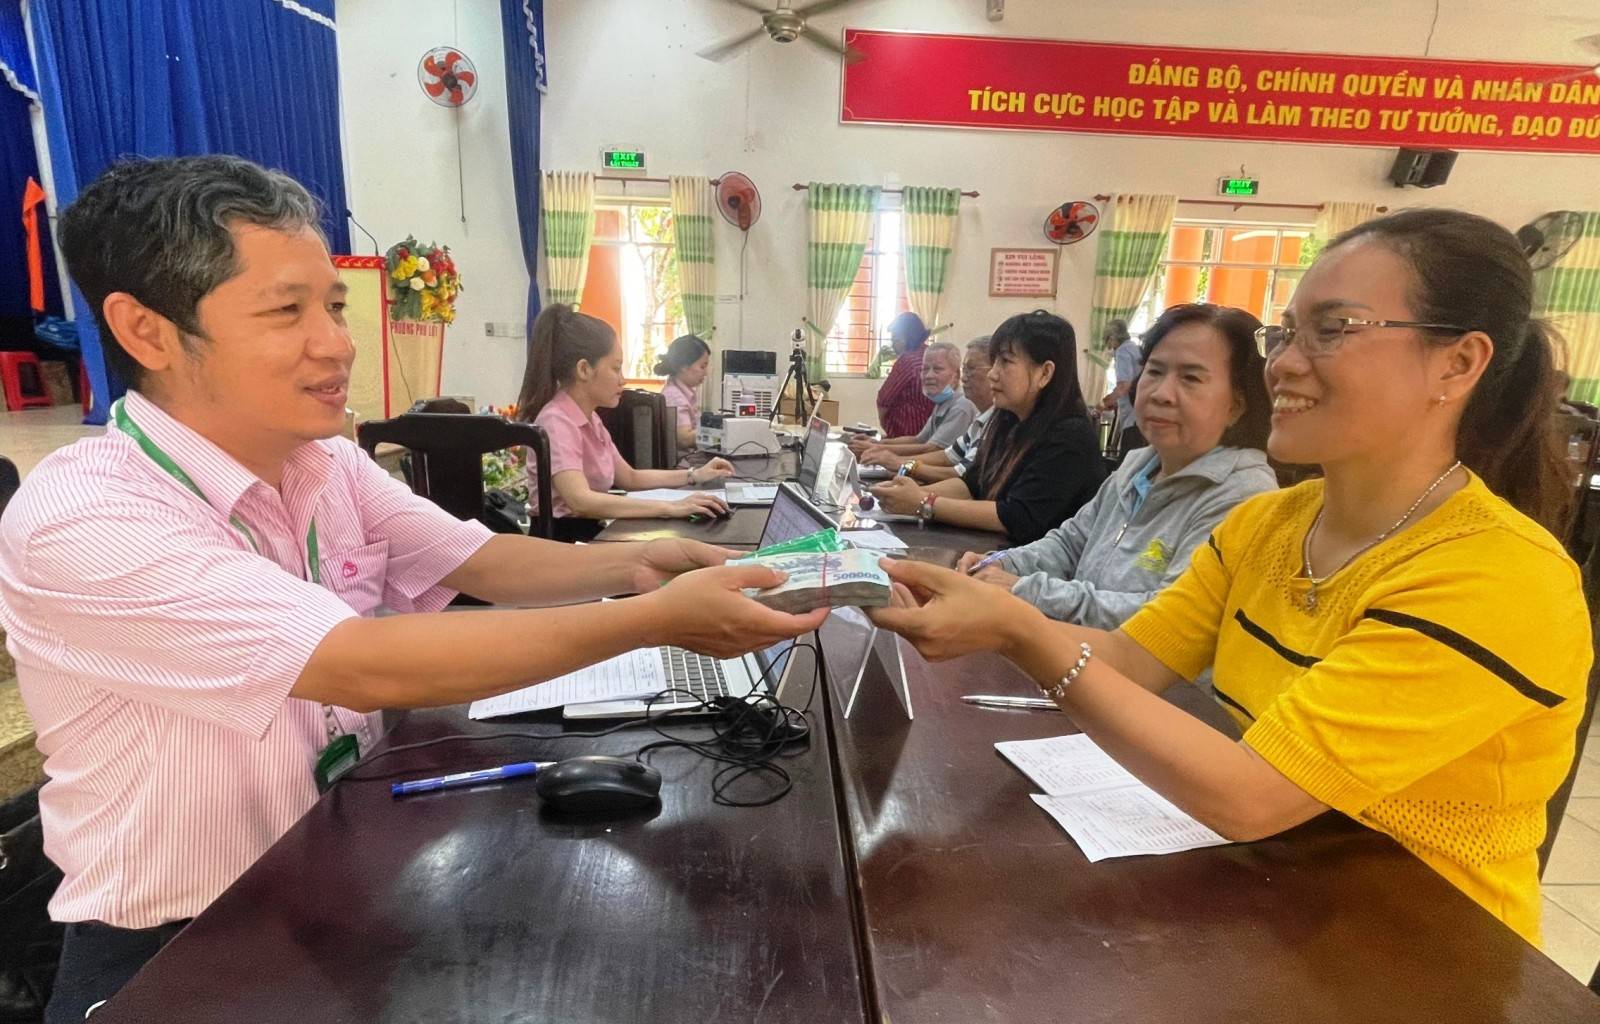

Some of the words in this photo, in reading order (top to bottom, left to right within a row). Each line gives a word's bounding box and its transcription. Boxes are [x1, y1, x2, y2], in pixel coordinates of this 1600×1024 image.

[1128, 58, 1200, 88] ĐẢNG
[1206, 64, 1248, 93] BỘ,
[1256, 67, 1336, 95] CHÍNH
[1342, 70, 1426, 99] QUYỀN
[1433, 75, 1465, 100] VÀ
[1471, 77, 1544, 103] NHÂN
[1548, 79, 1600, 105] DÂN
[967, 86, 1026, 113] TÍCH
[1033, 91, 1085, 119] CỰC
[1093, 96, 1144, 122] HỌC
[1153, 95, 1200, 125] TẬP
[1207, 99, 1239, 124] VÀ
[1246, 100, 1302, 126] LÀM
[1309, 106, 1371, 130] THEO
[1379, 109, 1413, 131] TƯ
[1416, 106, 1504, 137] TƯỞNG,
[1511, 115, 1563, 141] ĐẠO
[612, 152, 637, 160] EXIT
